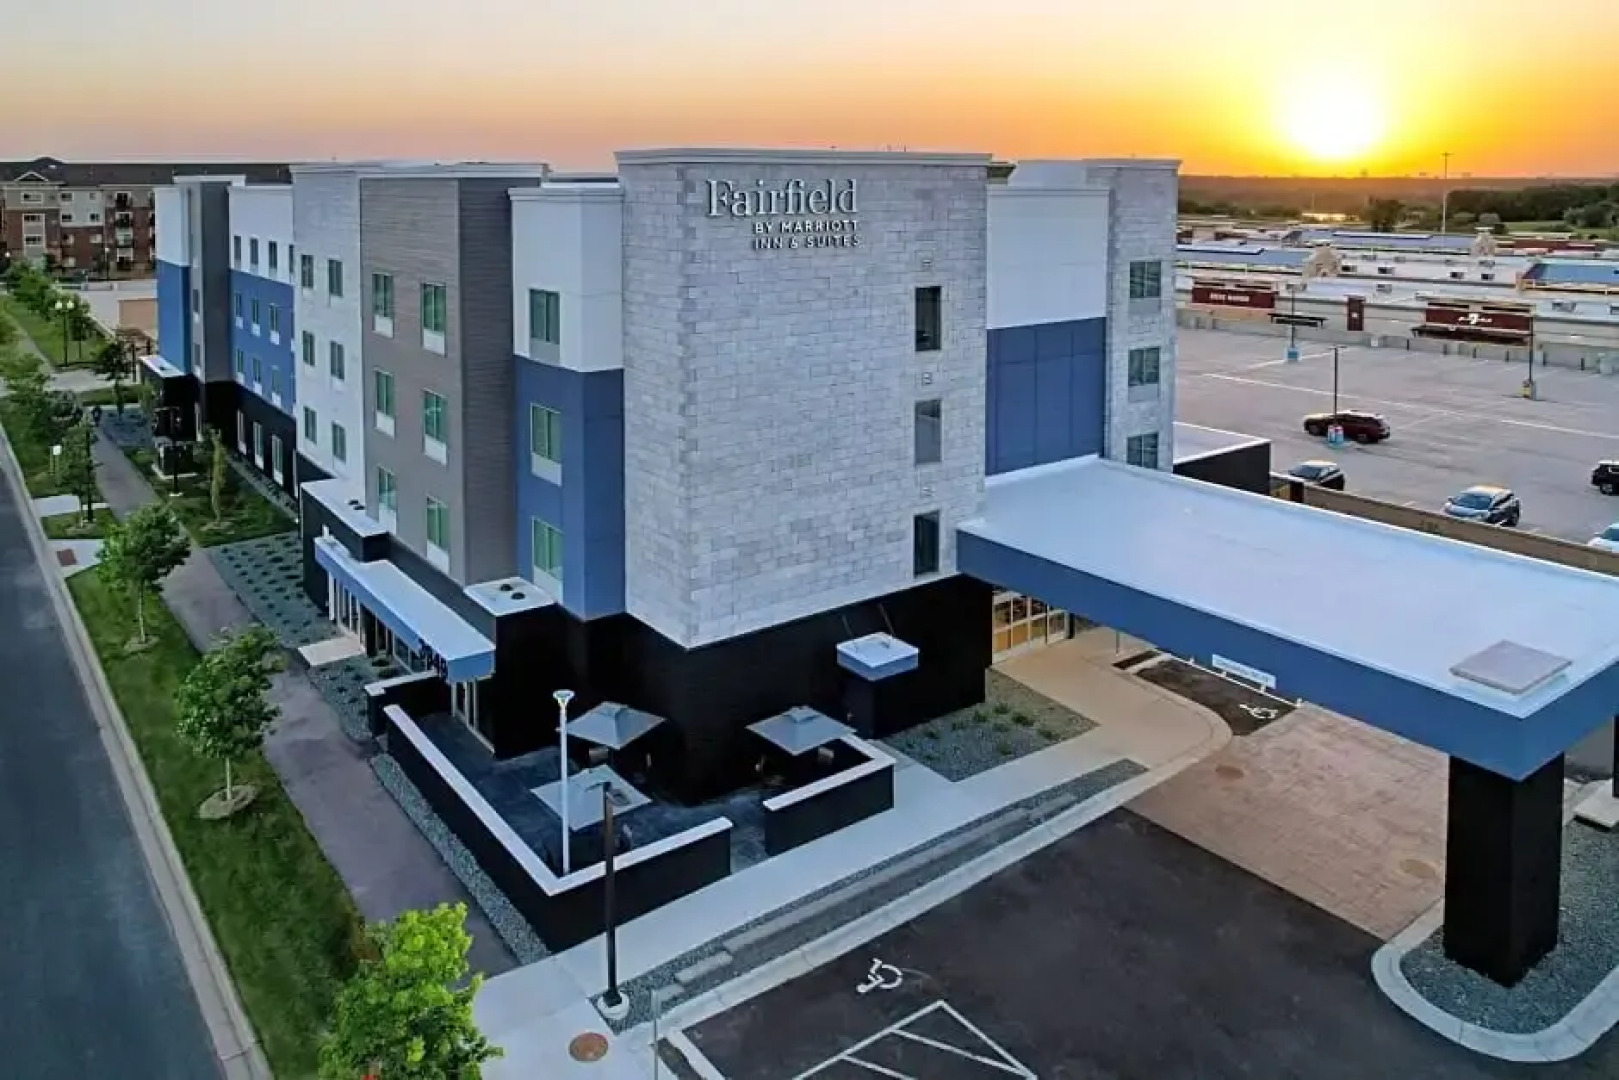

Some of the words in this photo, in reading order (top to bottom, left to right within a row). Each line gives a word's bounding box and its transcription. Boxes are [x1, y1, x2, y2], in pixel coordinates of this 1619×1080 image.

[706, 178, 859, 217] Fairfield
[755, 221, 773, 234] BY
[780, 219, 859, 234] MARRIOTT
[755, 237, 783, 250] INN
[790, 237, 799, 249] &
[806, 235, 861, 249] SUITES
